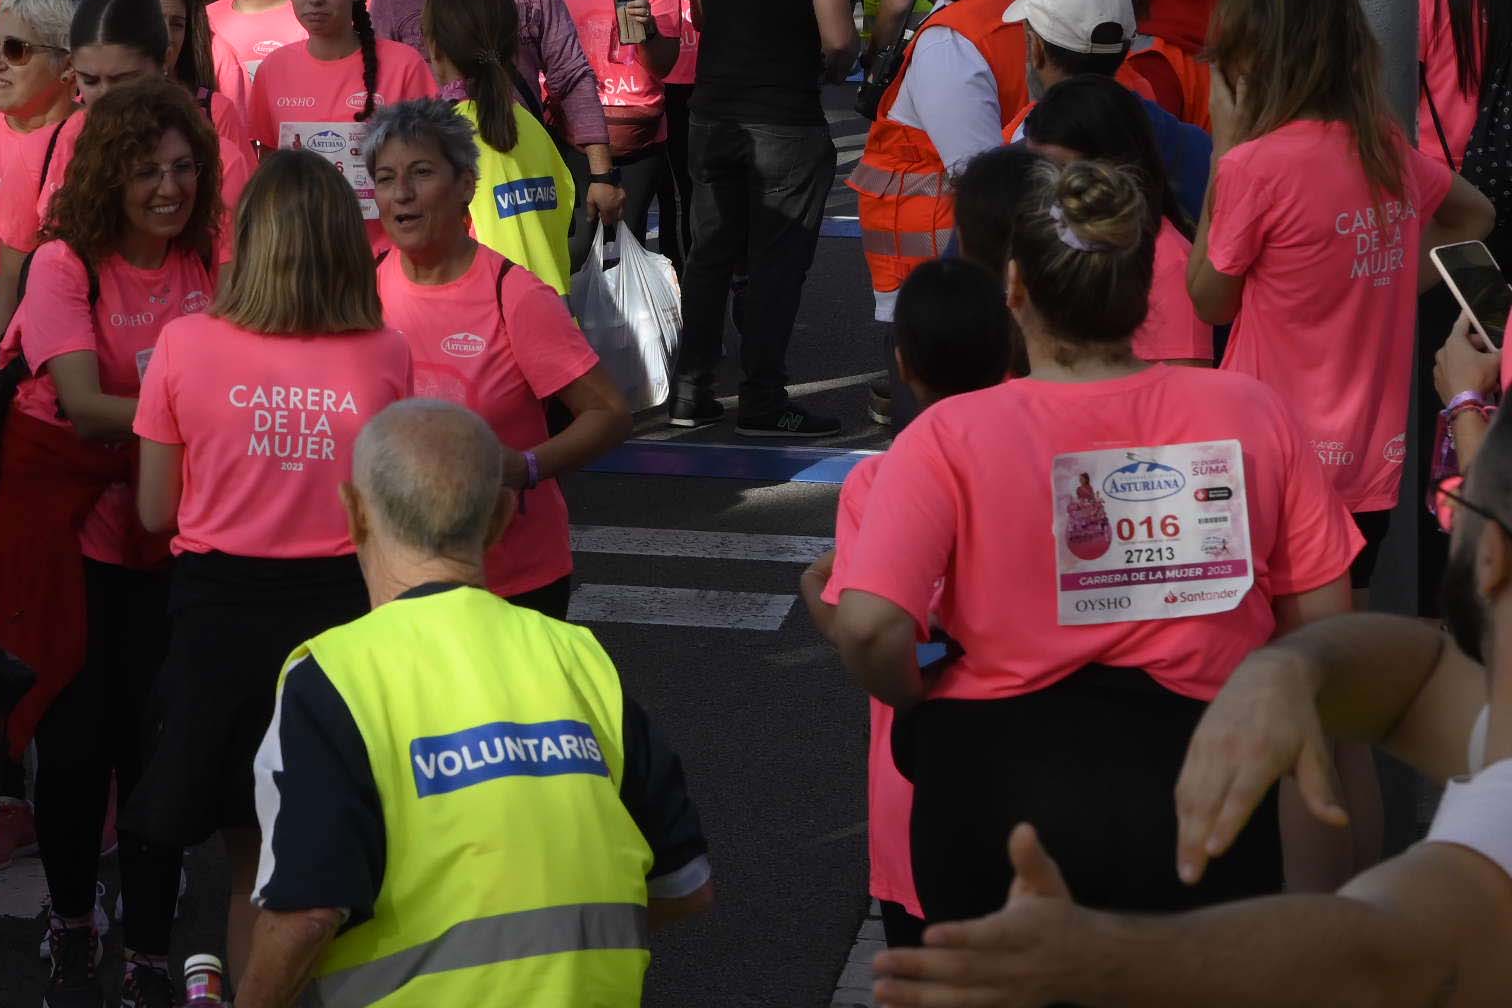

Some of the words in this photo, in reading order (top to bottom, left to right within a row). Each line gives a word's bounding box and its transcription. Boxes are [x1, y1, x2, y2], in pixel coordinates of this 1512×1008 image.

[604, 76, 640, 95] SAL
[277, 97, 316, 108] OYSHO
[1356, 231, 1379, 256] DE
[1350, 248, 1405, 279] MUJER
[228, 383, 358, 414] CARRERA
[253, 410, 293, 437] DE
[298, 410, 332, 437] LA
[247, 432, 336, 461] MUJER
[1191, 465, 1229, 477] SUMA
[1110, 478, 1180, 494] ASTURIANA
[1116, 514, 1181, 541] 016
[1124, 546, 1176, 565] 27213
[1079, 574, 1129, 586] CARRERA
[1131, 572, 1146, 582] DE
[1149, 571, 1164, 581] LA
[1165, 568, 1204, 580] MUJER
[1207, 565, 1233, 576] 2023
[1075, 596, 1132, 613] OYSHO
[1179, 589, 1238, 604] Santander
[414, 733, 601, 780] VOLUNTARIS
